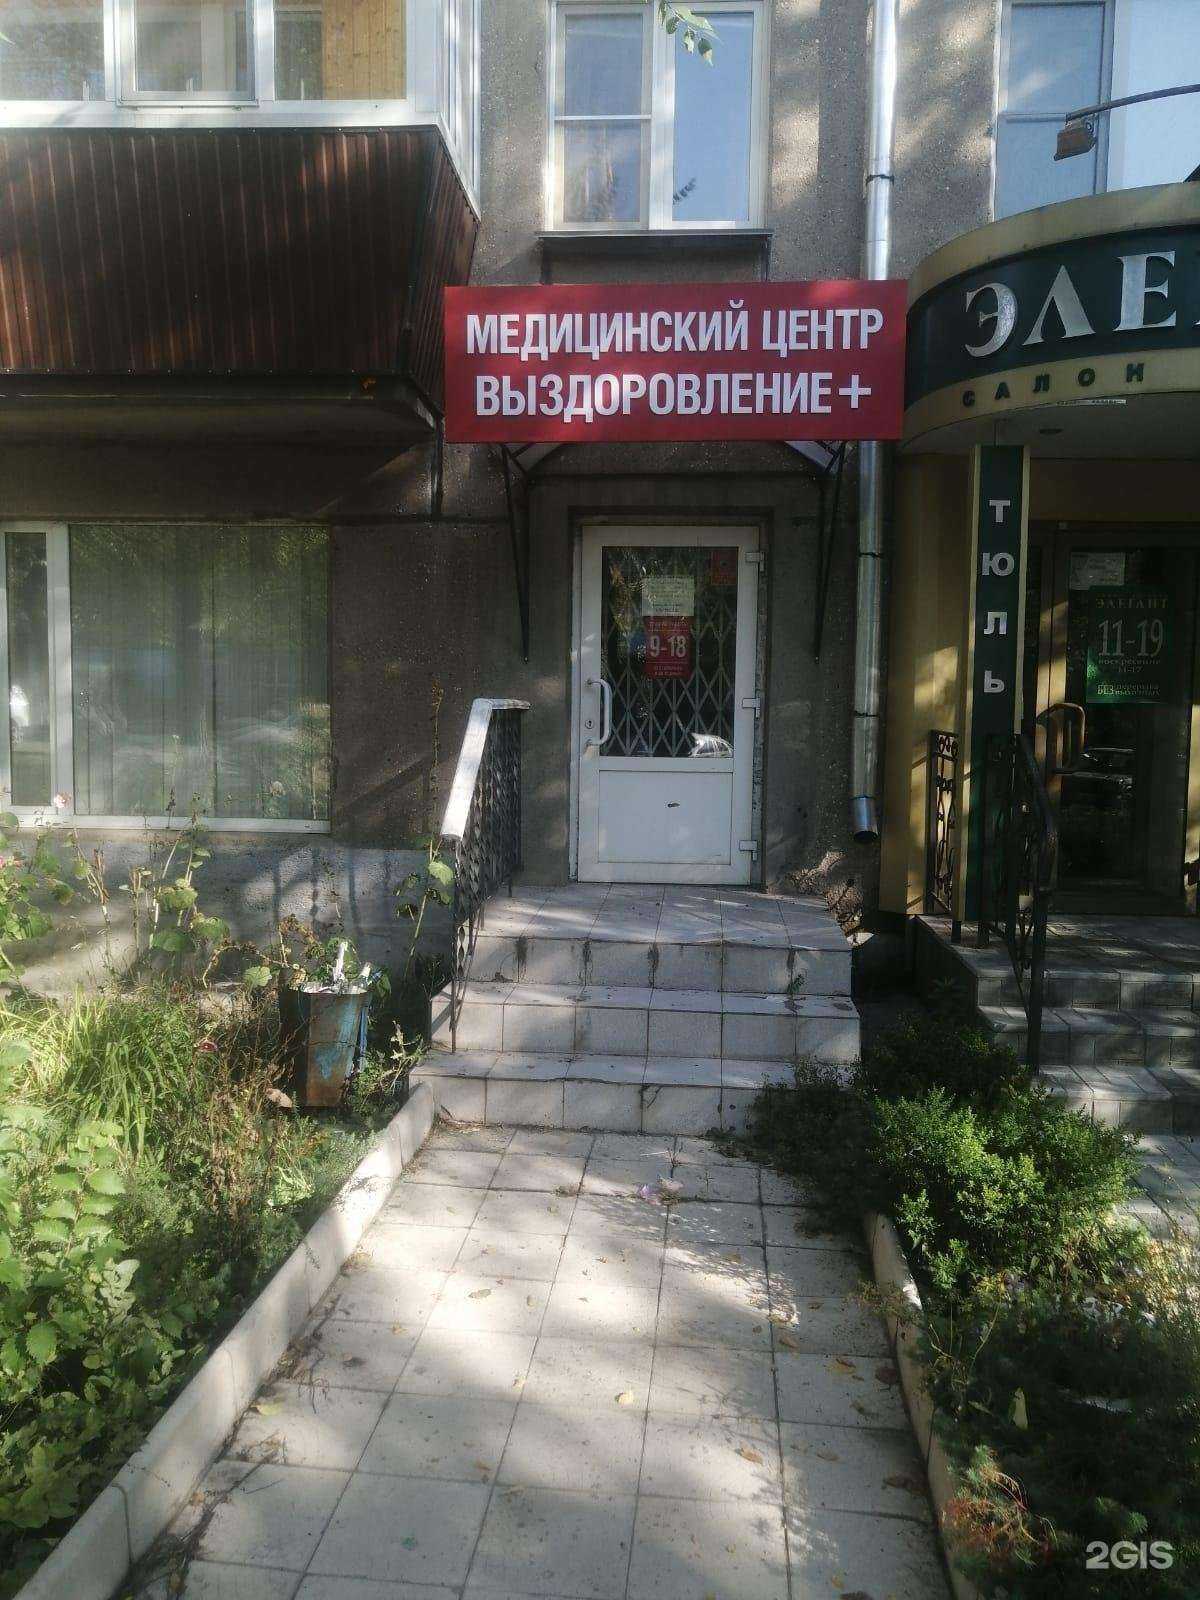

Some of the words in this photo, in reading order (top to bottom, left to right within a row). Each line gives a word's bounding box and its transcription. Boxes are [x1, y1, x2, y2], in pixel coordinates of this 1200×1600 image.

[466, 300, 748, 361] МЕДИЦИНСКИЙ
[762, 308, 884, 358] ЦЕНТР
[965, 251, 1200, 358] ЭЛЕ
[963, 363, 1145, 408] САЛОН
[981, 499, 1015, 693] ТЮЛЬ
[649, 635, 687, 658] 9-18
[1098, 618, 1164, 657] 11-19
